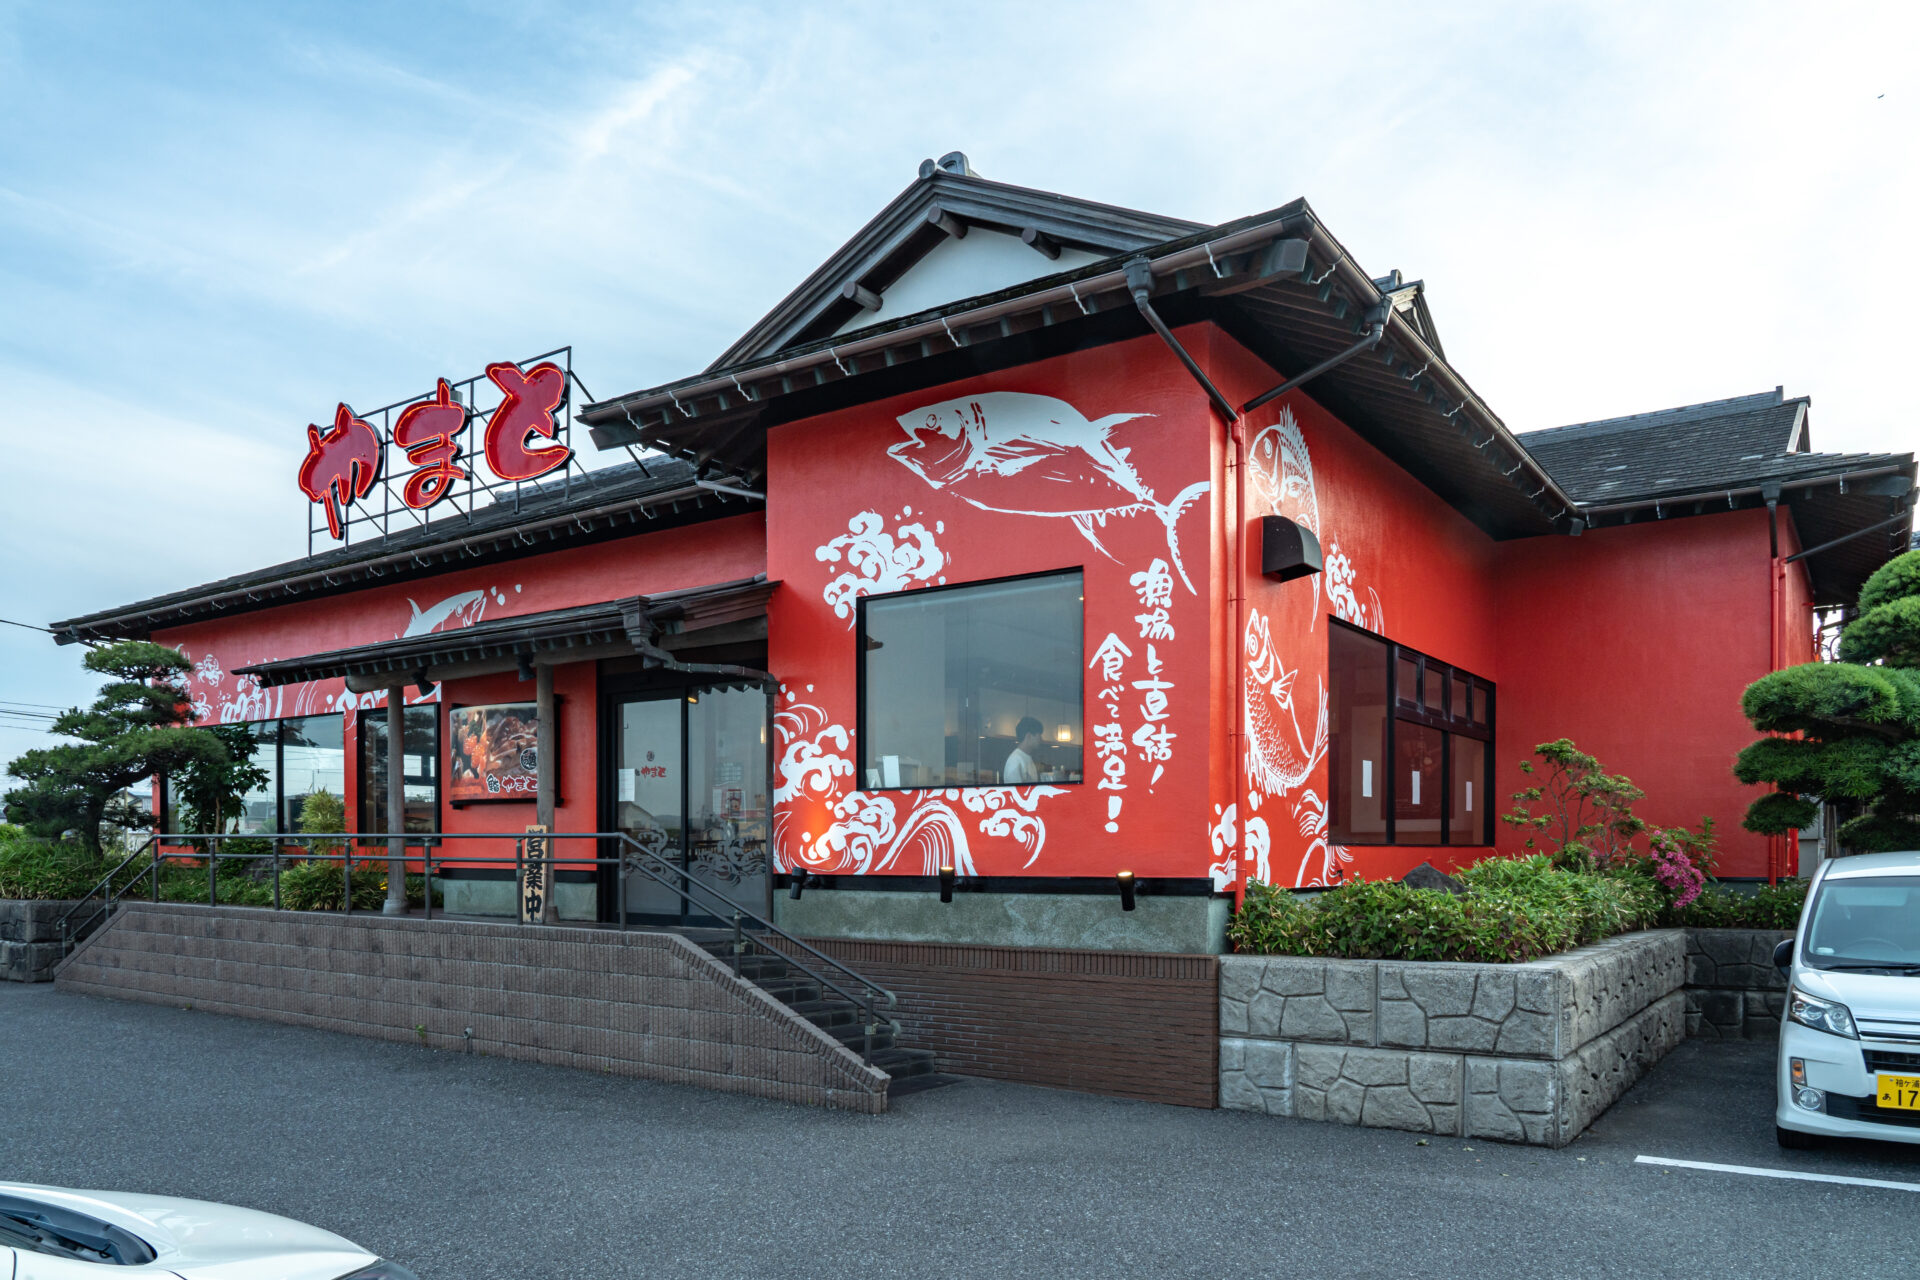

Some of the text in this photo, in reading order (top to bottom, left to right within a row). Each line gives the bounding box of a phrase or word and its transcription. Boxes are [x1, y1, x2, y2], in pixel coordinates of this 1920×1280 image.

[298, 361, 575, 540] やまと
[1089, 632, 1132, 833] 食べて満足！
[1882, 1089, 1919, 1107] あ 17
